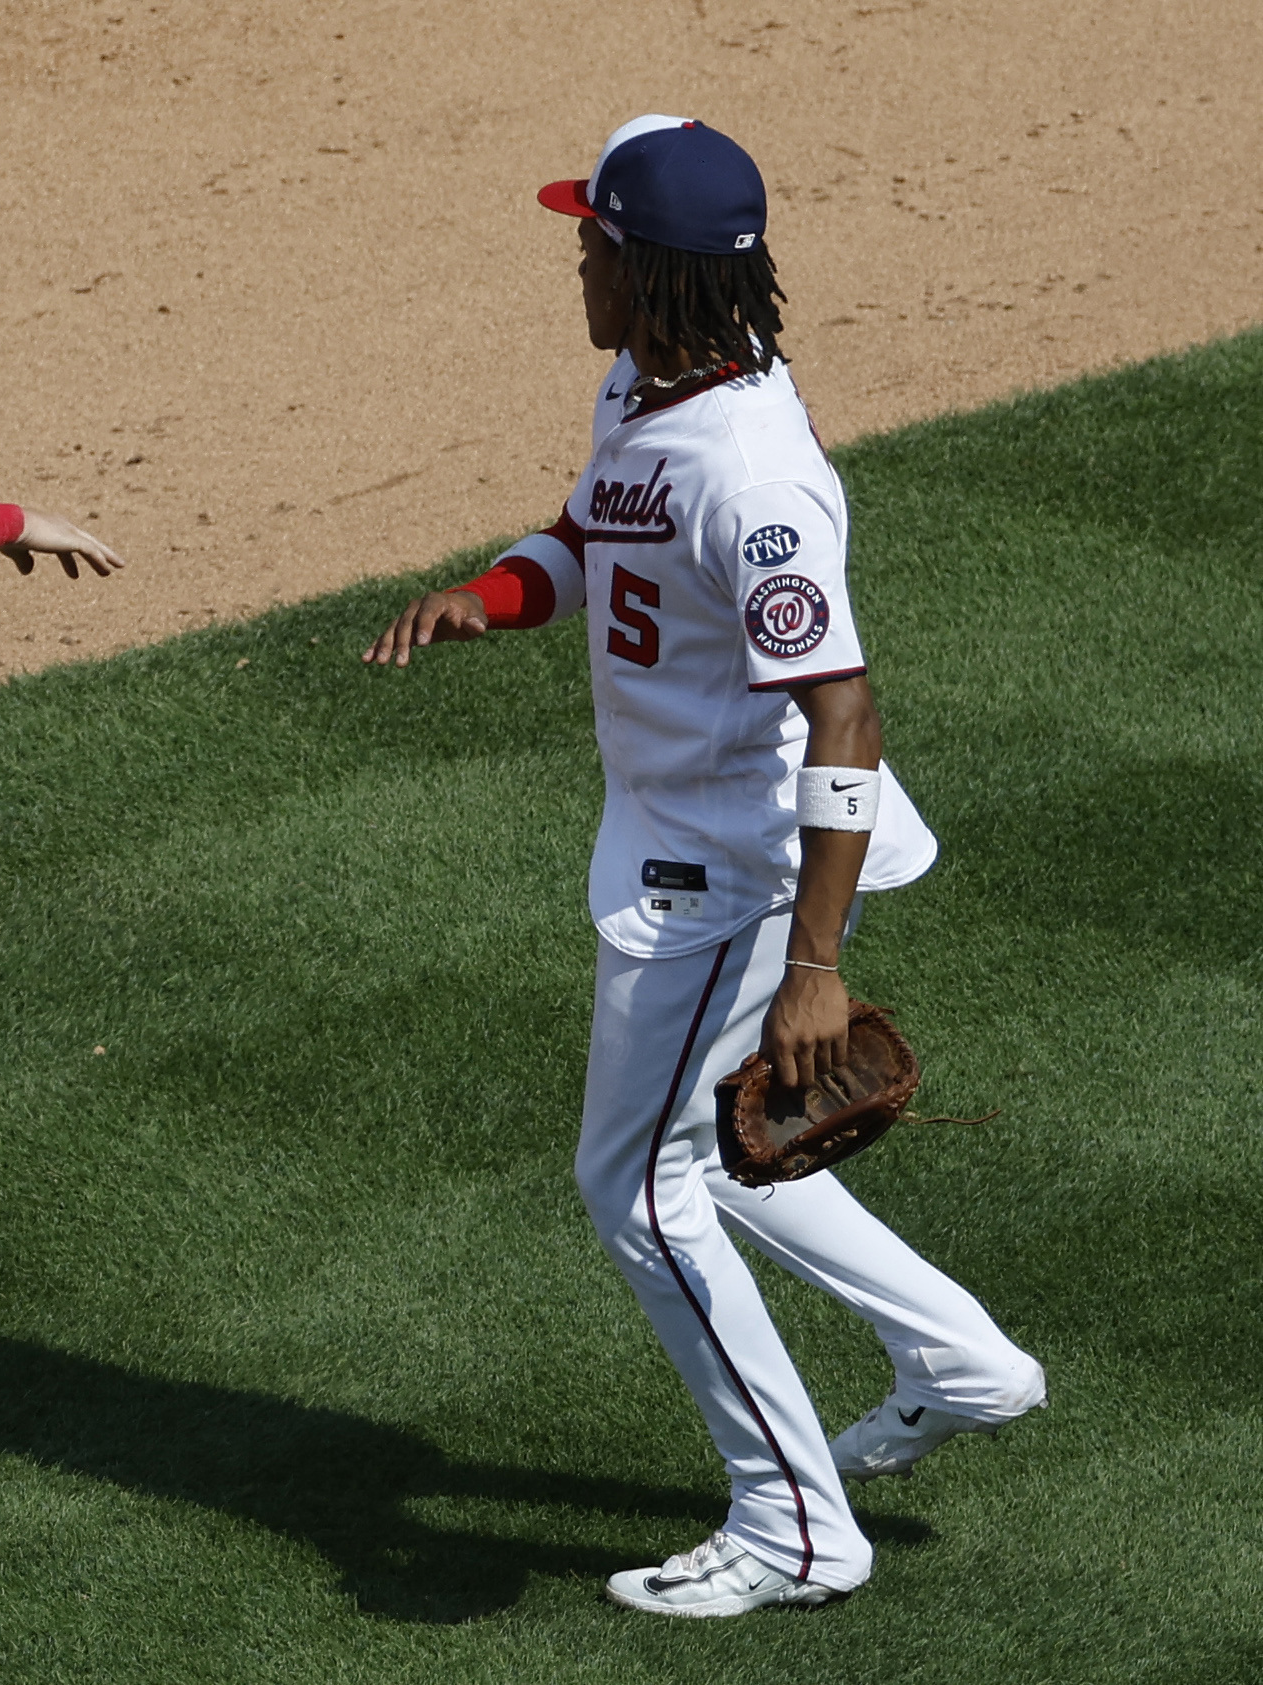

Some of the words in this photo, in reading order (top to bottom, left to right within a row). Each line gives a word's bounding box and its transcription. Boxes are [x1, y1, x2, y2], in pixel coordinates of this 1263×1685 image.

[744, 534, 800, 564] TNL
[749, 577, 823, 612] WASHINGTON
[607, 562, 661, 669] 5
[756, 624, 824, 655] NATIONALS
[847, 797, 858, 816] 5
